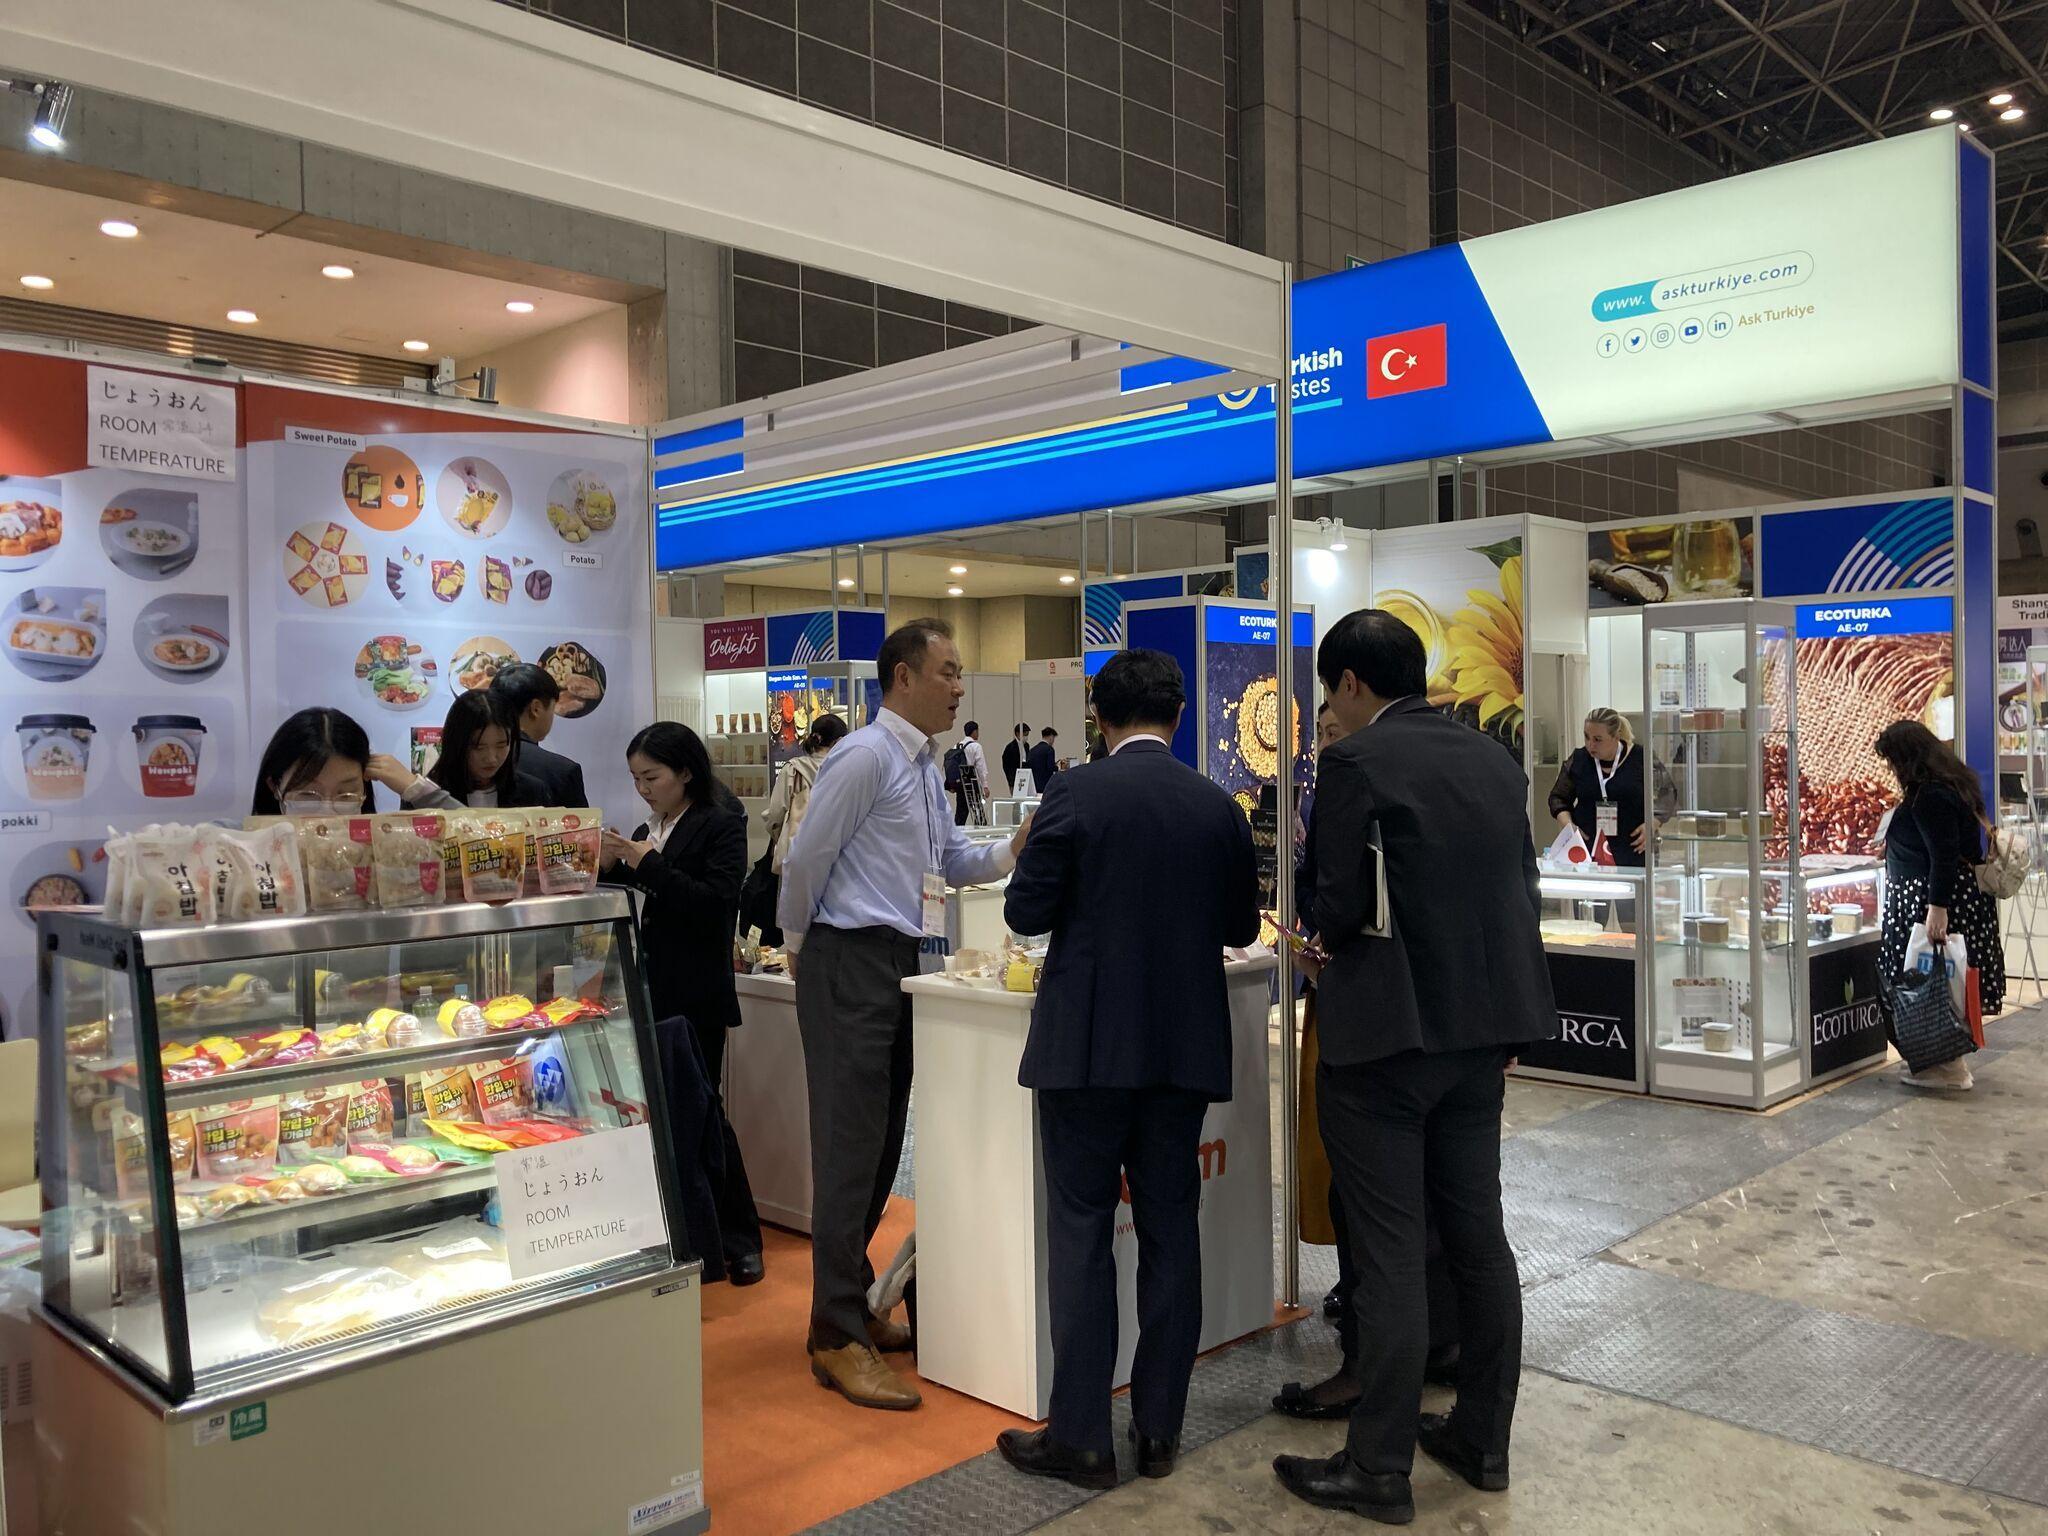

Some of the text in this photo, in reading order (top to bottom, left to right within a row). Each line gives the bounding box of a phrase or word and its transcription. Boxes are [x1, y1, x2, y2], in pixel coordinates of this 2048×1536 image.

[1602, 263, 1799, 312] www. askturkiye.com
[1738, 314, 1763, 327] Ask
[1763, 303, 1816, 323] Turkiye
[1291, 346, 1343, 376] rkish
[104, 380, 207, 413] じょうおん
[1266, 377, 1331, 404] Tstes
[99, 414, 157, 436] ROOM
[294, 430, 357, 447] Sweet Potato
[99, 443, 226, 474] TEMPERATURE
[570, 554, 596, 565] Potato
[1239, 615, 1278, 629] ECOTURK
[1814, 606, 1893, 622] ECOTURKA
[1252, 631, 1271, 641] AE-07
[1836, 622, 1870, 634] AE-07
[709, 632, 761, 664] Delight
[1555, 1017, 1628, 1050] RCA
[524, 1167, 605, 1198] じょうおん
[525, 1204, 571, 1227] ROOM
[529, 1218, 628, 1255] TEMPERATURE
